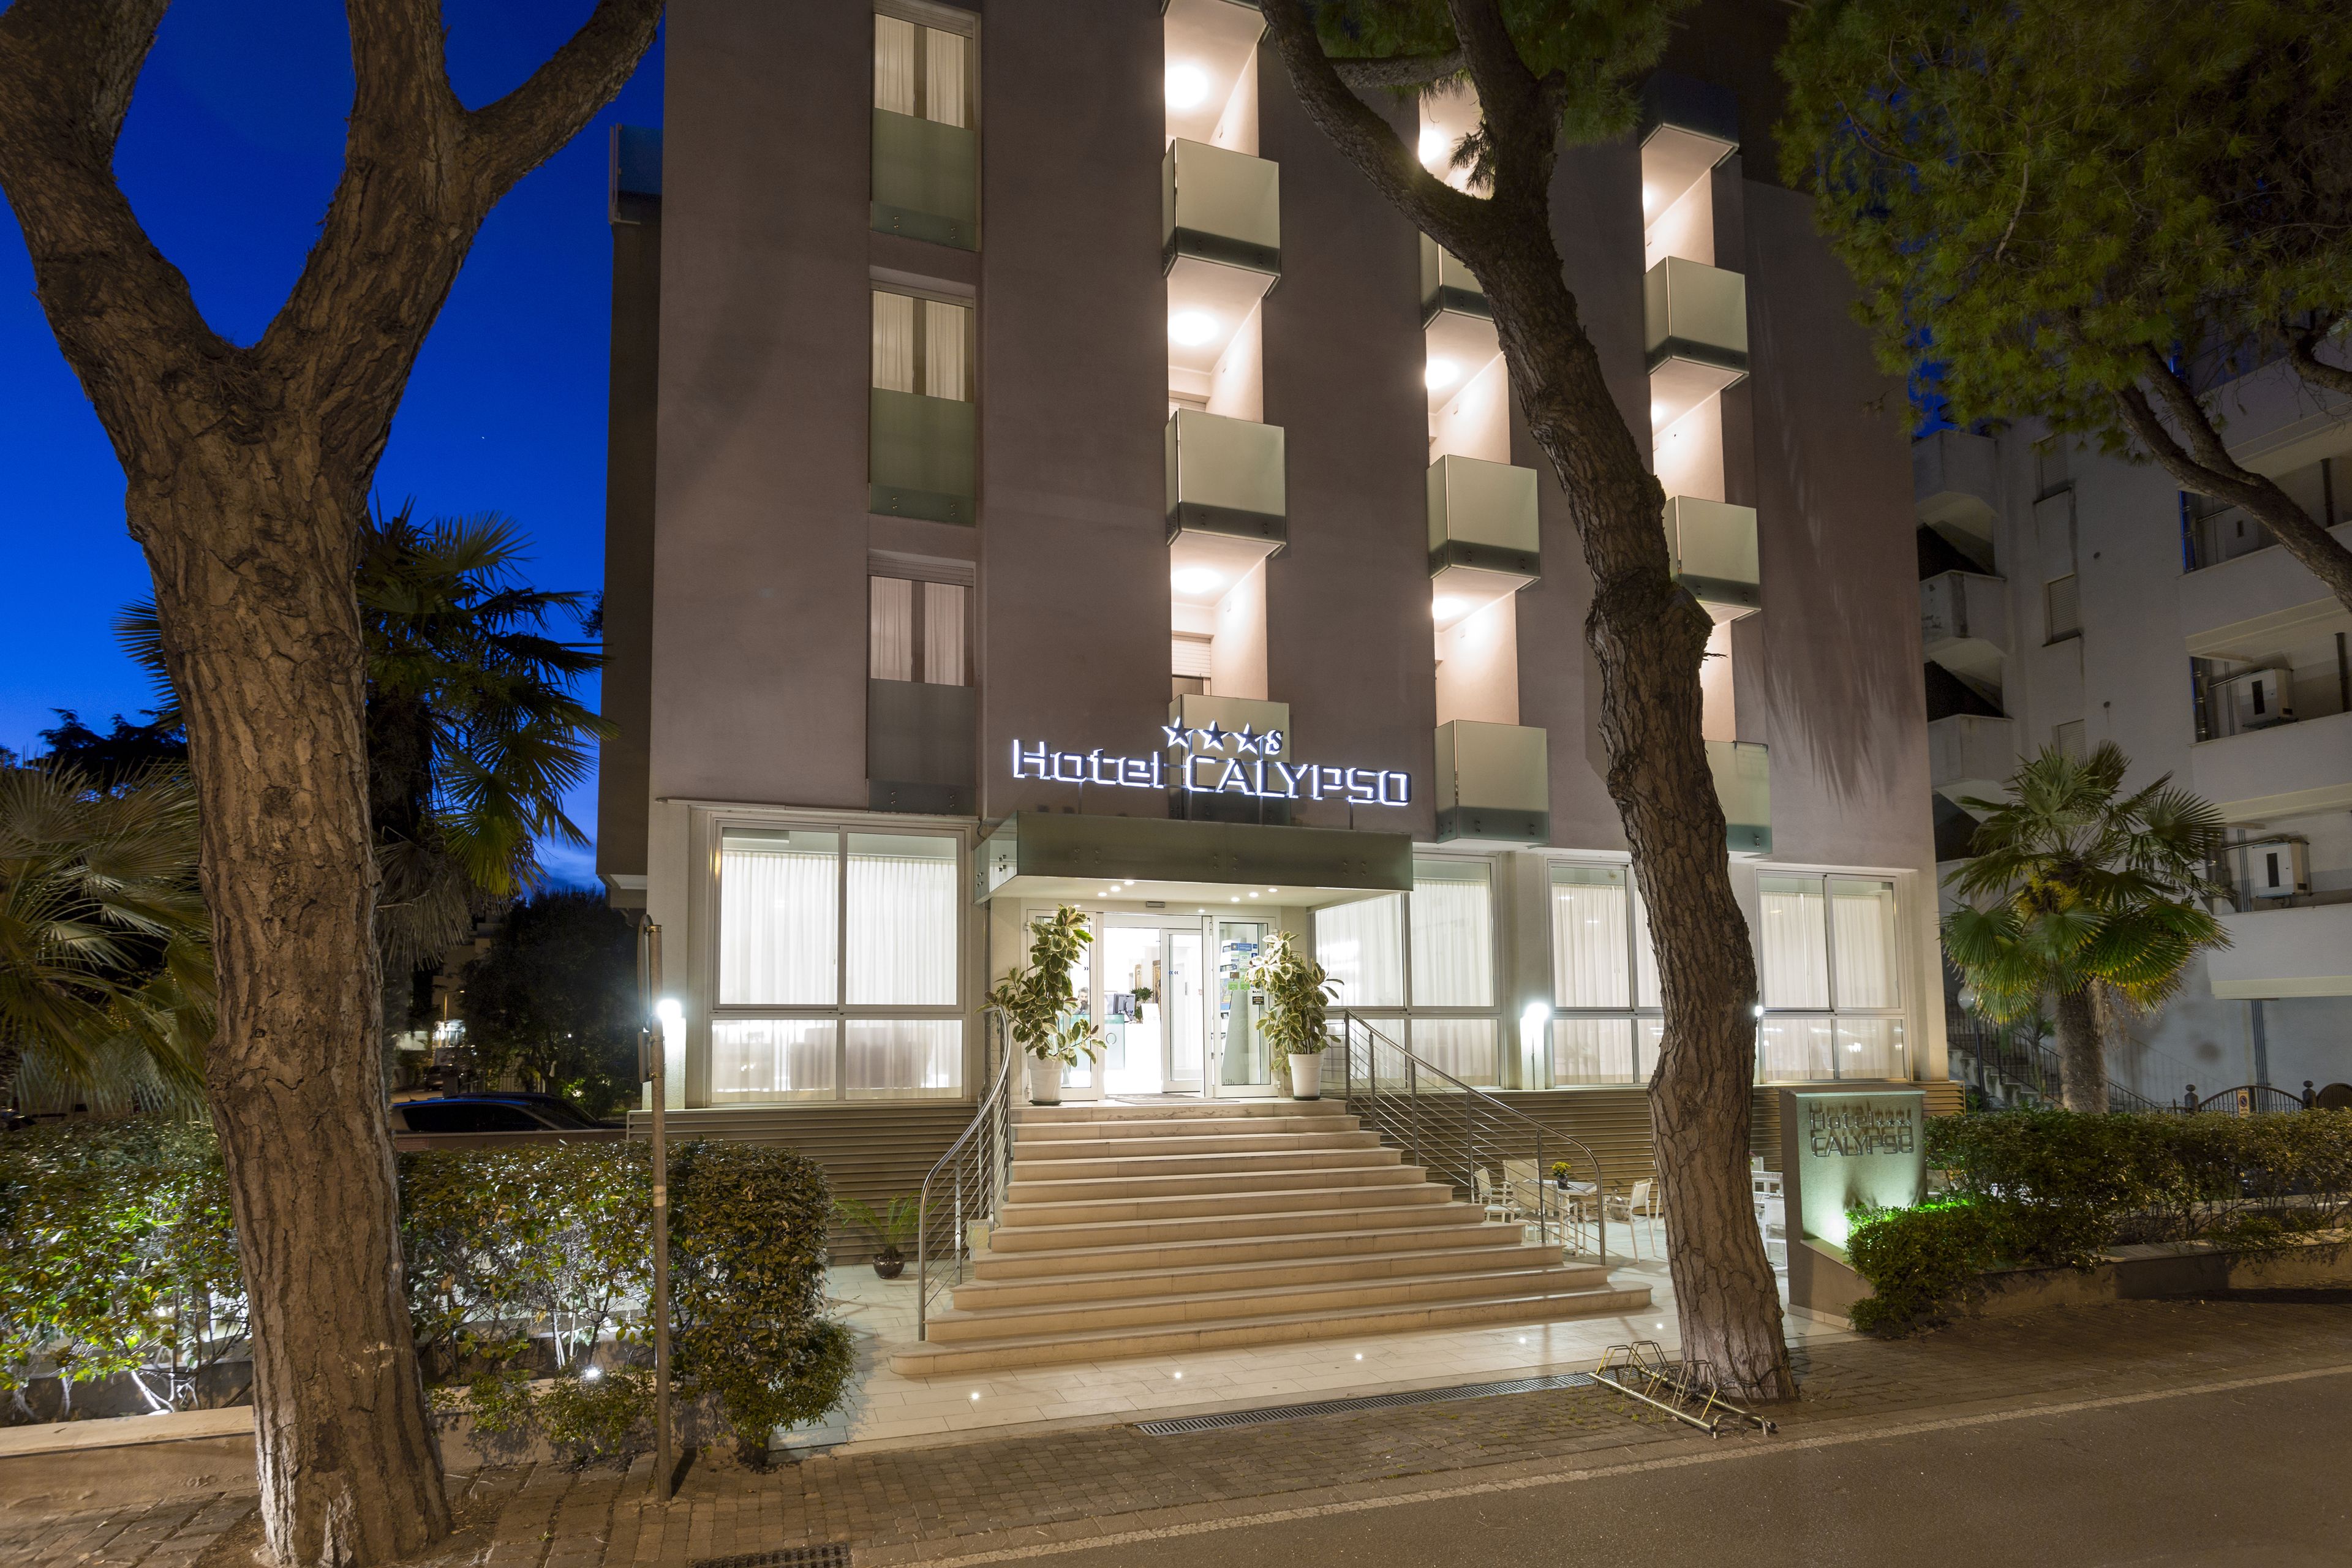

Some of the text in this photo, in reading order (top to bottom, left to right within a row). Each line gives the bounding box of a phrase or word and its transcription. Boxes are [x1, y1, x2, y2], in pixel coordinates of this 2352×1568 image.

[1012, 739, 1411, 806] Hotel CALYPSO
[1810, 1110, 1874, 1130] Hotel
[1811, 1134, 1914, 1157] CALYPSO
